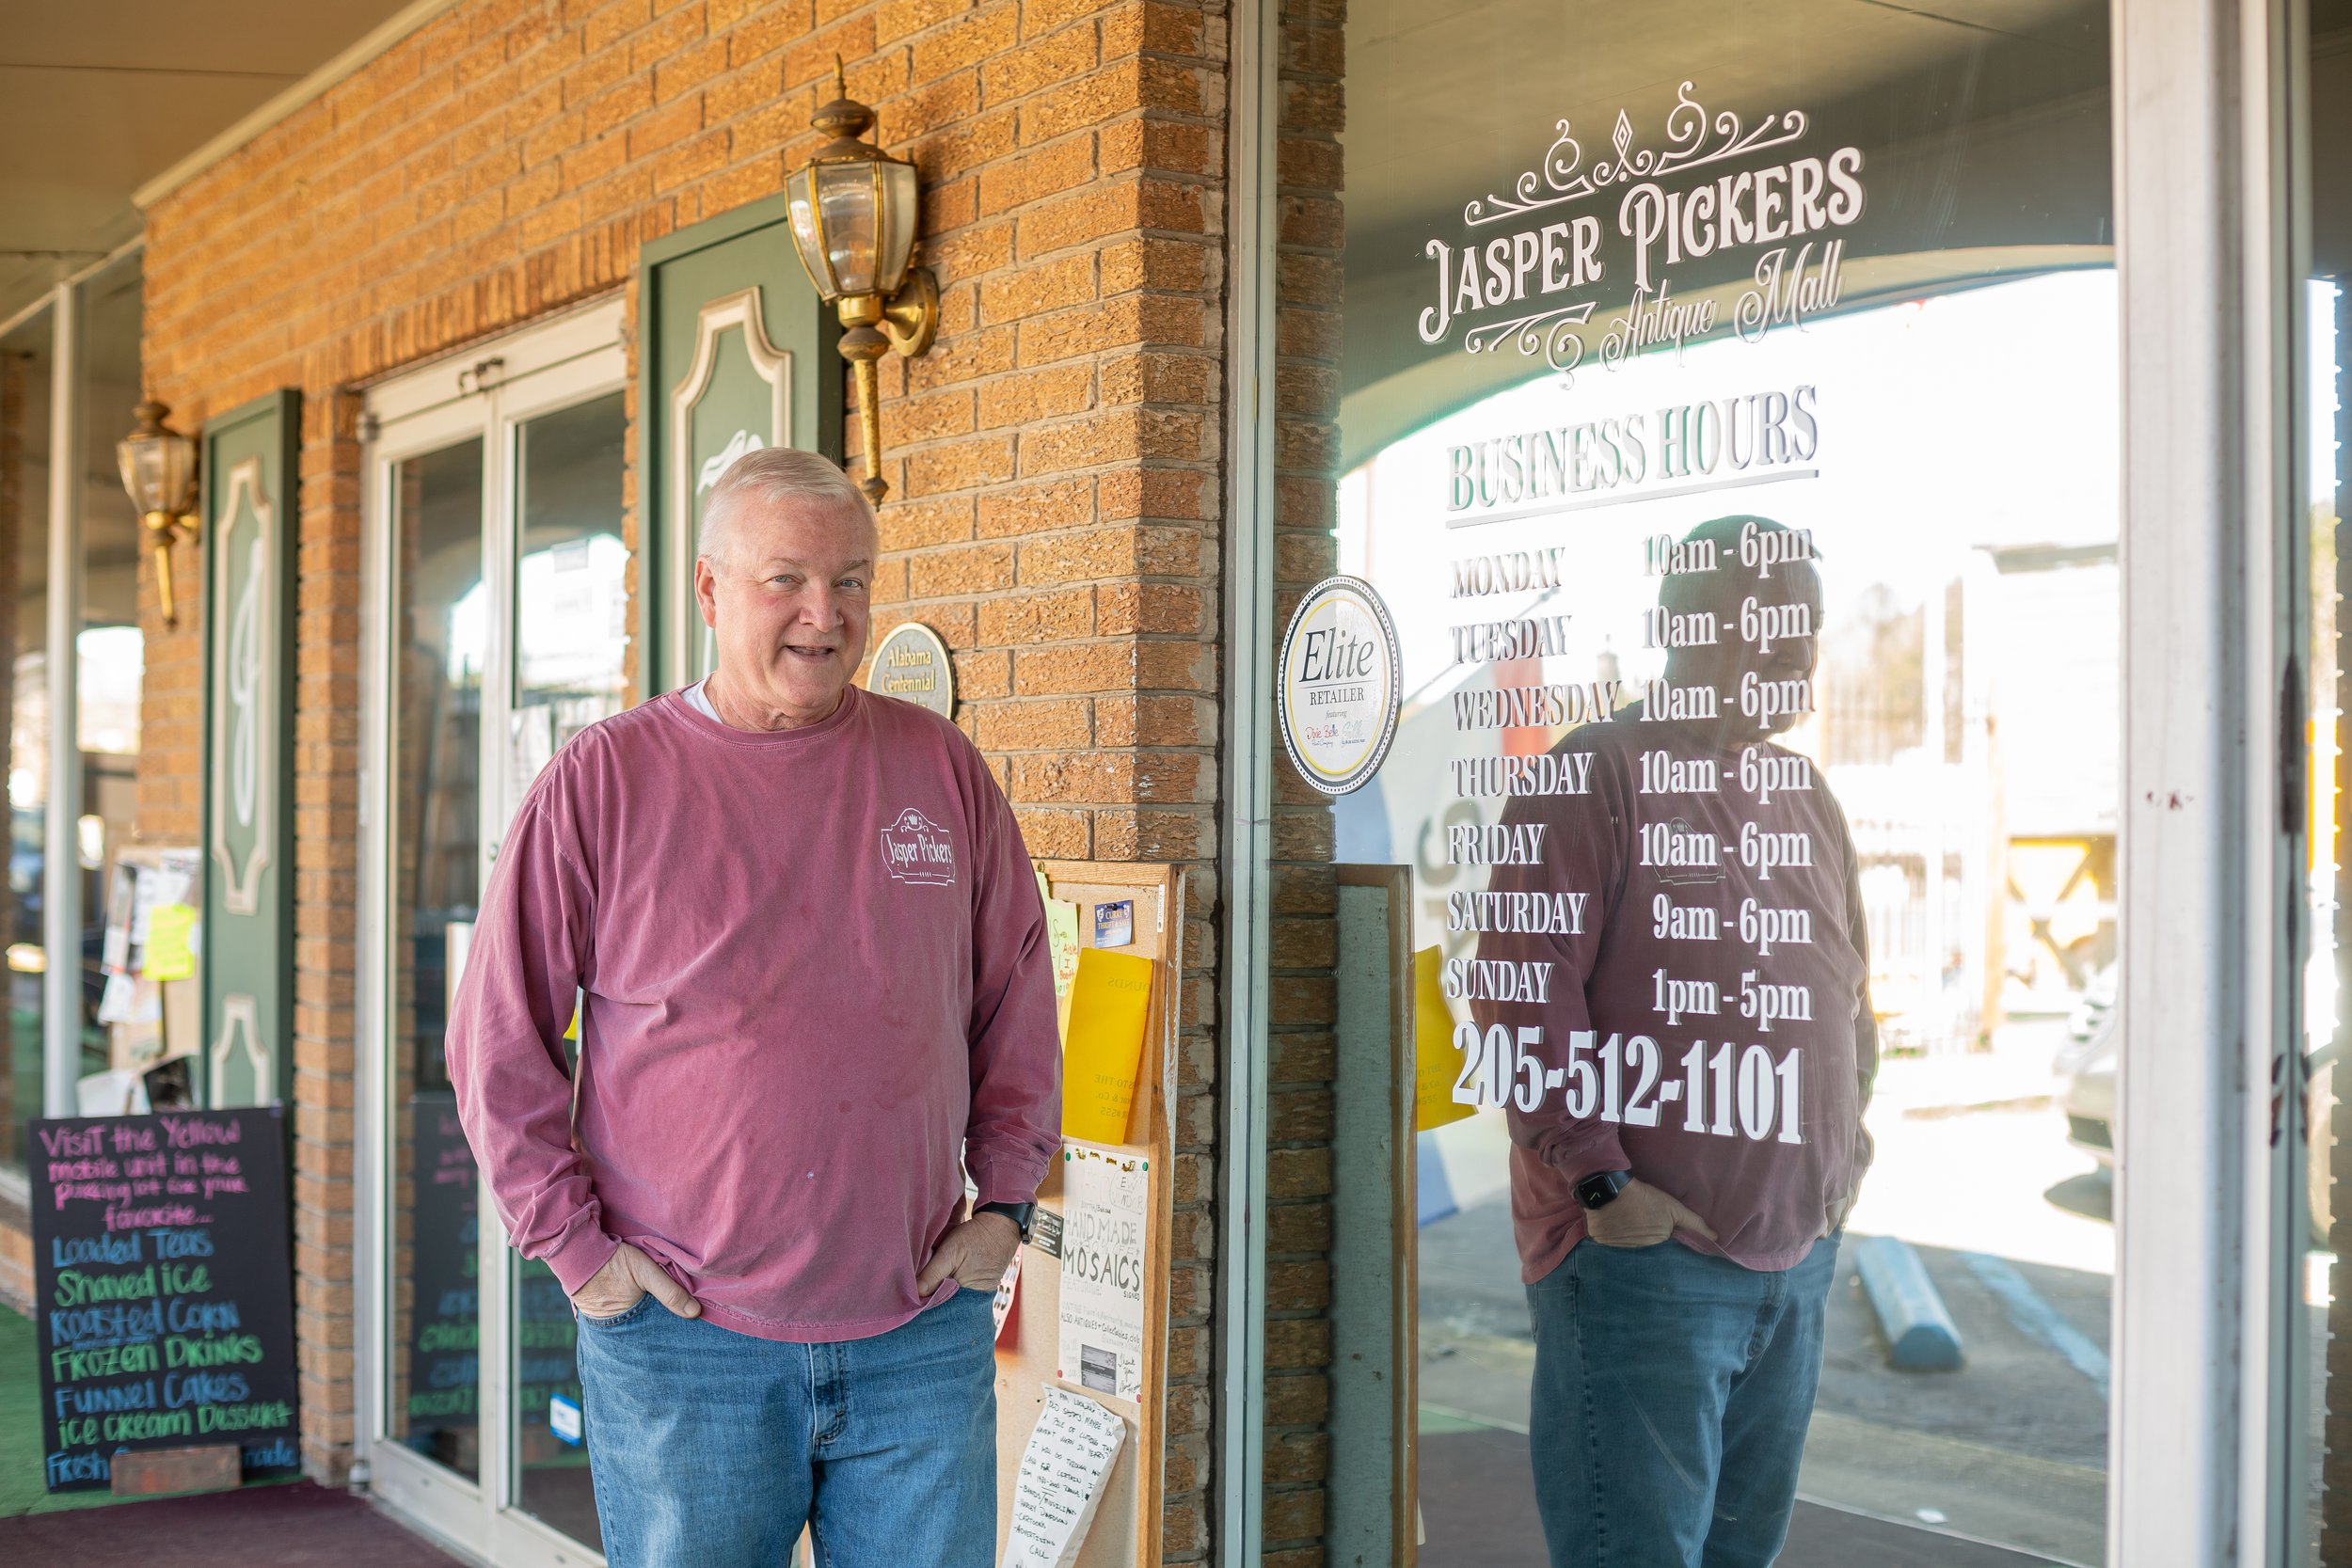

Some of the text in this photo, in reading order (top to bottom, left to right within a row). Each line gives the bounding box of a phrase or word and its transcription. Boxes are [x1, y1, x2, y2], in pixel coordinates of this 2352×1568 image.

[1599, 239, 1847, 371] Antique Mall
[1446, 385, 1819, 512] BUSINESS HOURS
[1449, 546, 1565, 599] MONDAY
[887, 644, 932, 668] Alabama
[1298, 626, 1375, 683] Elite
[1449, 614, 1571, 664] TUESDAY
[882, 669, 936, 693] Centennial
[1310, 688, 1365, 705] RETAILER
[1453, 679, 1622, 731] WEDNESDAY
[1450, 752, 1596, 798] THURSDAY
[886, 833, 952, 868] Jasper Pickers
[1447, 823, 1546, 865] FRIDAY
[1447, 891, 1588, 935] SATURDAY
[1447, 958, 1552, 1003] SUNDAY
[1452, 1021, 1805, 1145] 205-512-1101
[110, 1124, 158, 1153] the
[160, 1116, 242, 1148] Yellow
[174, 1150, 199, 1175] in
[200, 1151, 242, 1175] the
[53, 1227, 215, 1267] Loaded Teas
[1063, 1244, 1140, 1291] MOSAICS
[54, 1264, 158, 1307] Shaved
[55, 1370, 250, 1418] Funnel Cakes
